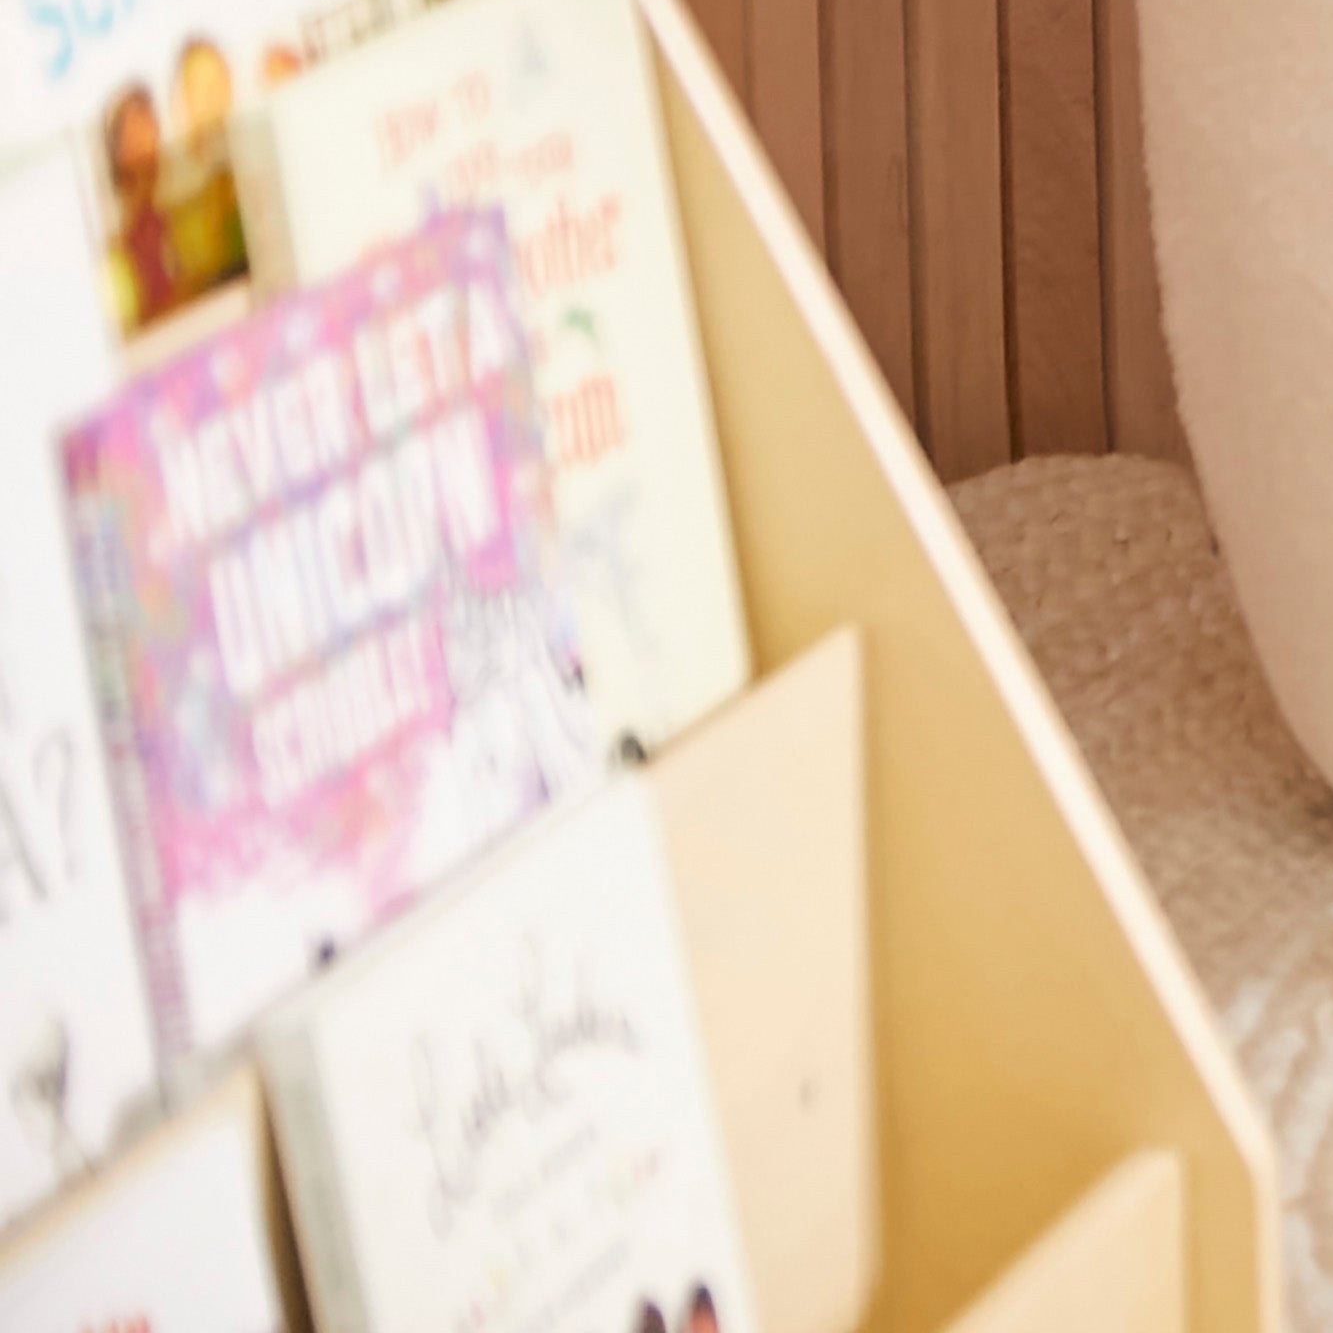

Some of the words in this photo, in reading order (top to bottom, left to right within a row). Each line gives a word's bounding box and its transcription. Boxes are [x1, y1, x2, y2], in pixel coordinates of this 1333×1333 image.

[150, 351, 354, 545] NEVER
[352, 285, 462, 451] LET
[462, 277, 510, 373] A
[208, 407, 500, 701] UNICORN
